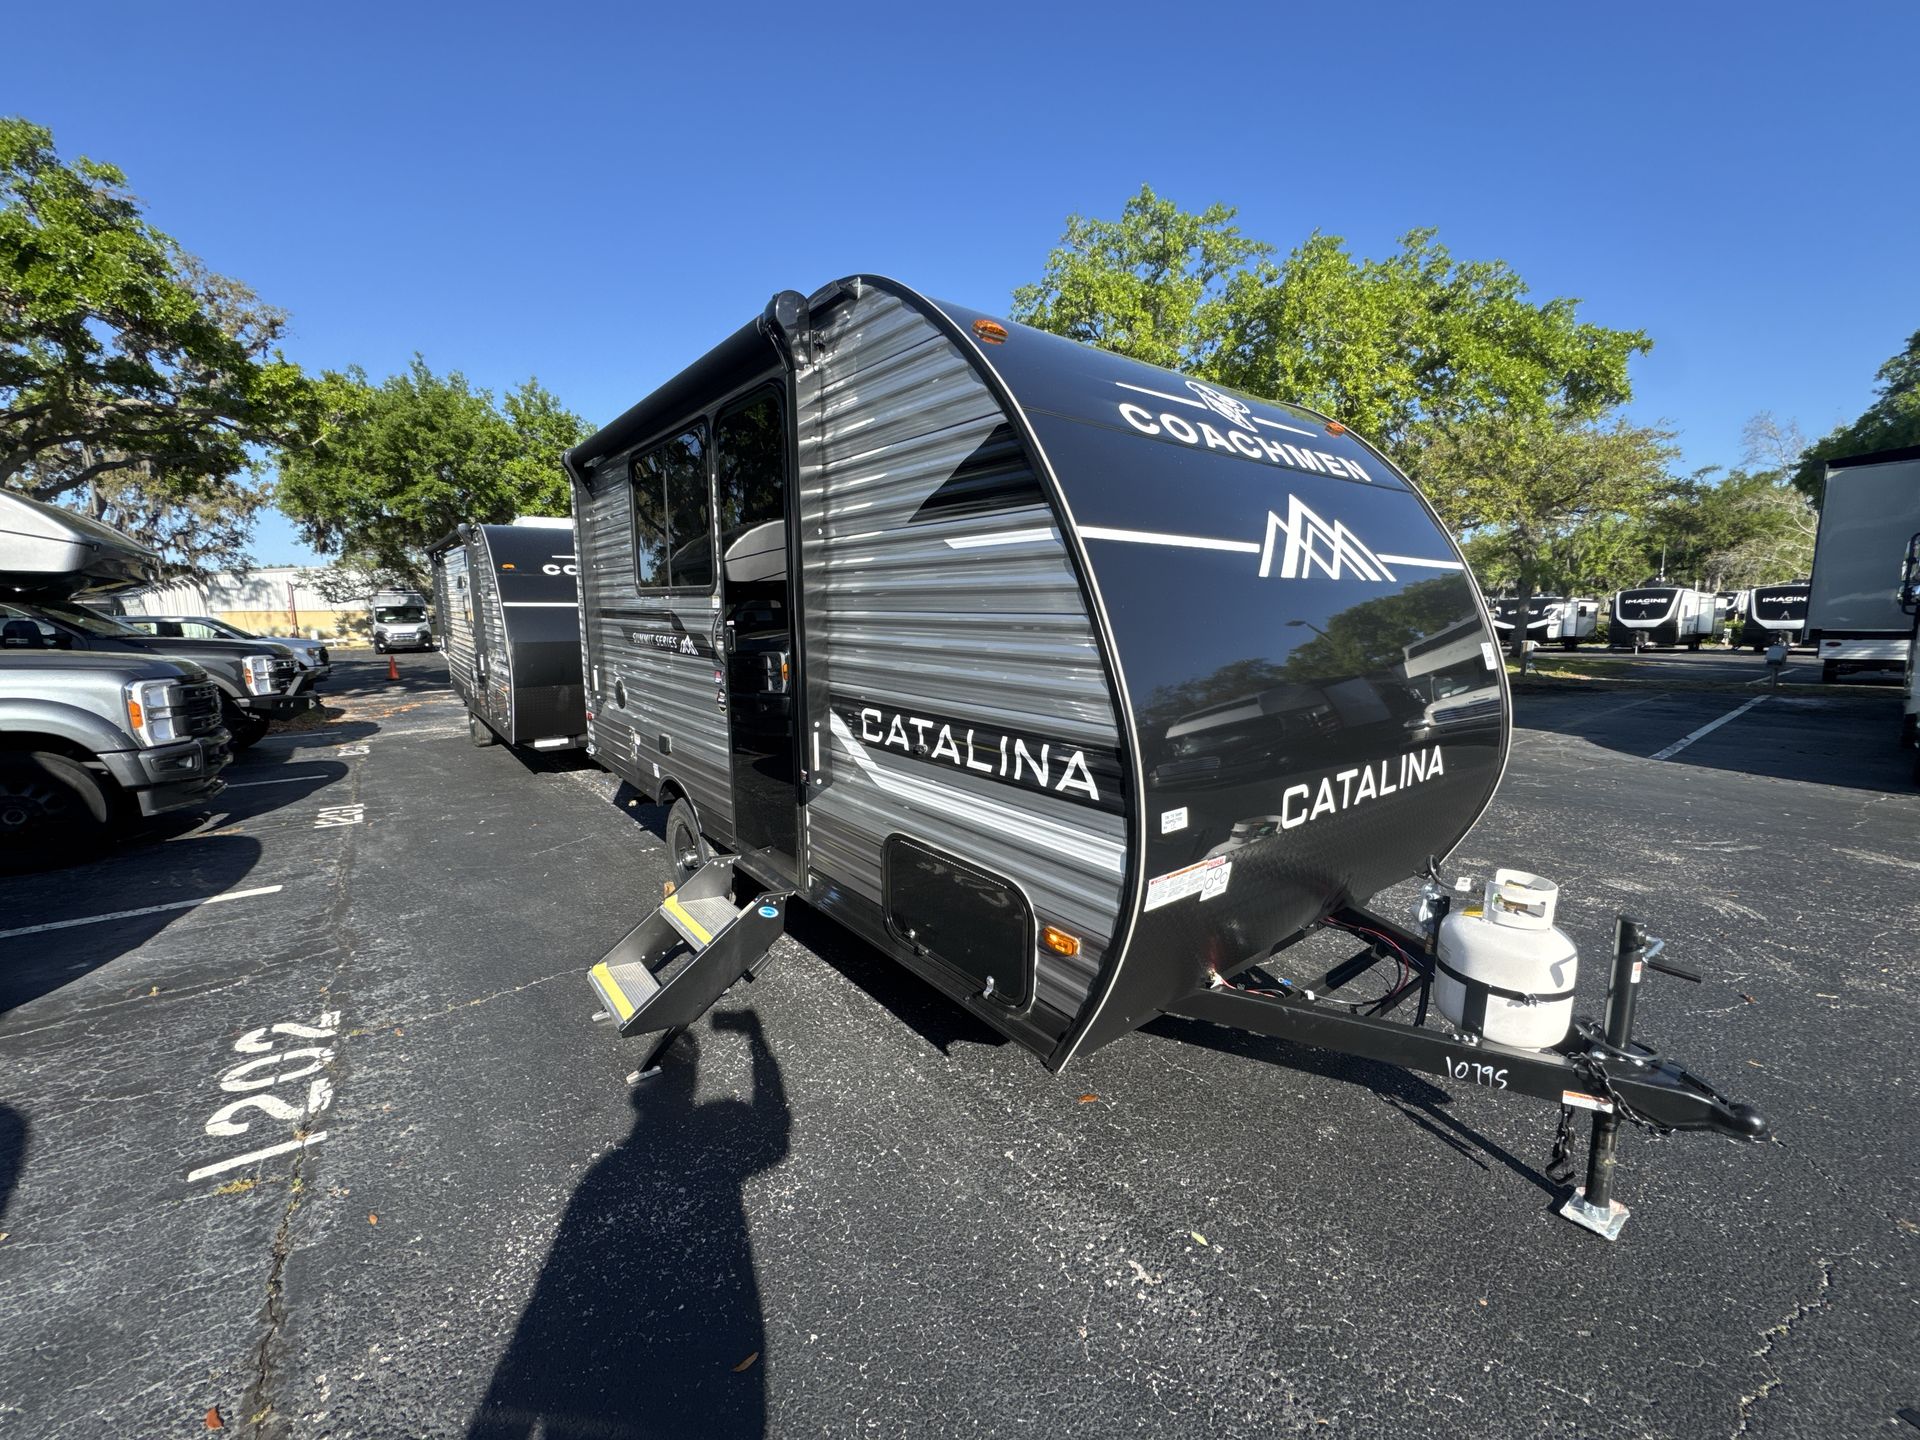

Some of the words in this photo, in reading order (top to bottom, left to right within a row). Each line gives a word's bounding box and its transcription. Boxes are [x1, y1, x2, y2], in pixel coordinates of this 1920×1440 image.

[1118, 402, 1372, 483] COACHMEN
[655, 635, 678, 649] SERIES
[860, 707, 1100, 801] CATALINA
[1281, 745, 1444, 829] CATALINA
